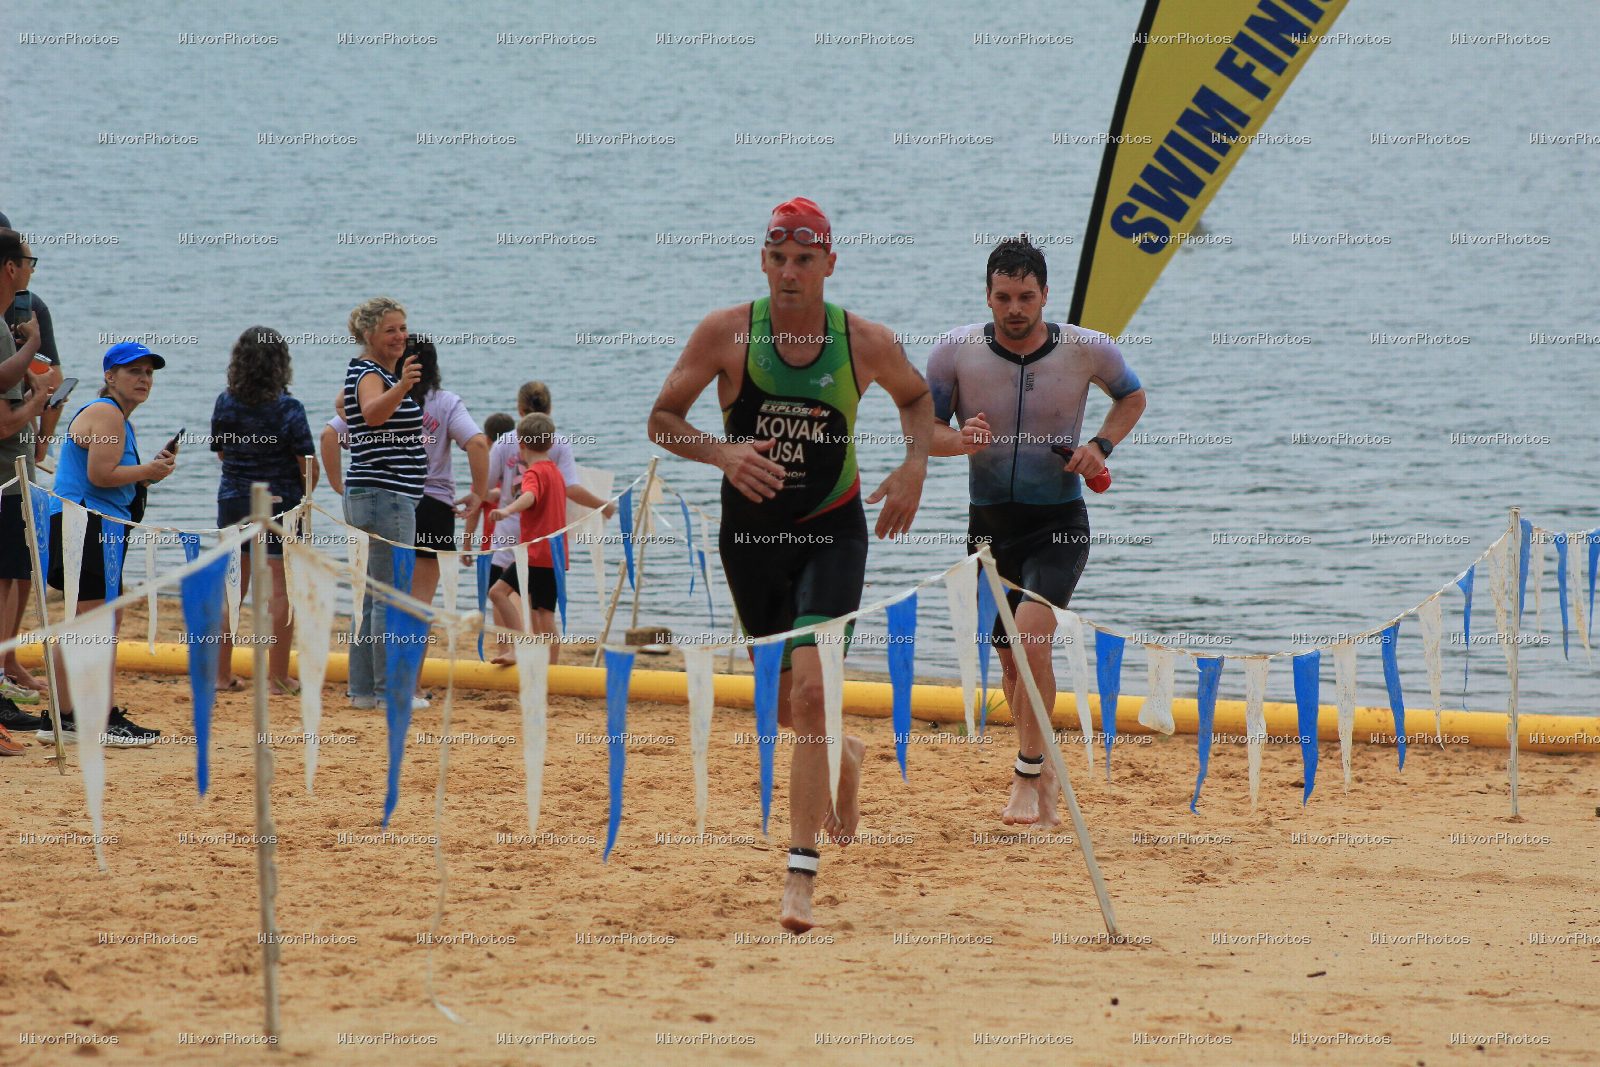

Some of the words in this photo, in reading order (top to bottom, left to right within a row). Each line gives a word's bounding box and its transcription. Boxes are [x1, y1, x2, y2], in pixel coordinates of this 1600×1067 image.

[1110, 84, 1251, 255] SWIM
[1214, 0, 1333, 101] FINI
[755, 414, 828, 442] KOVAK
[769, 442, 804, 463] USA
